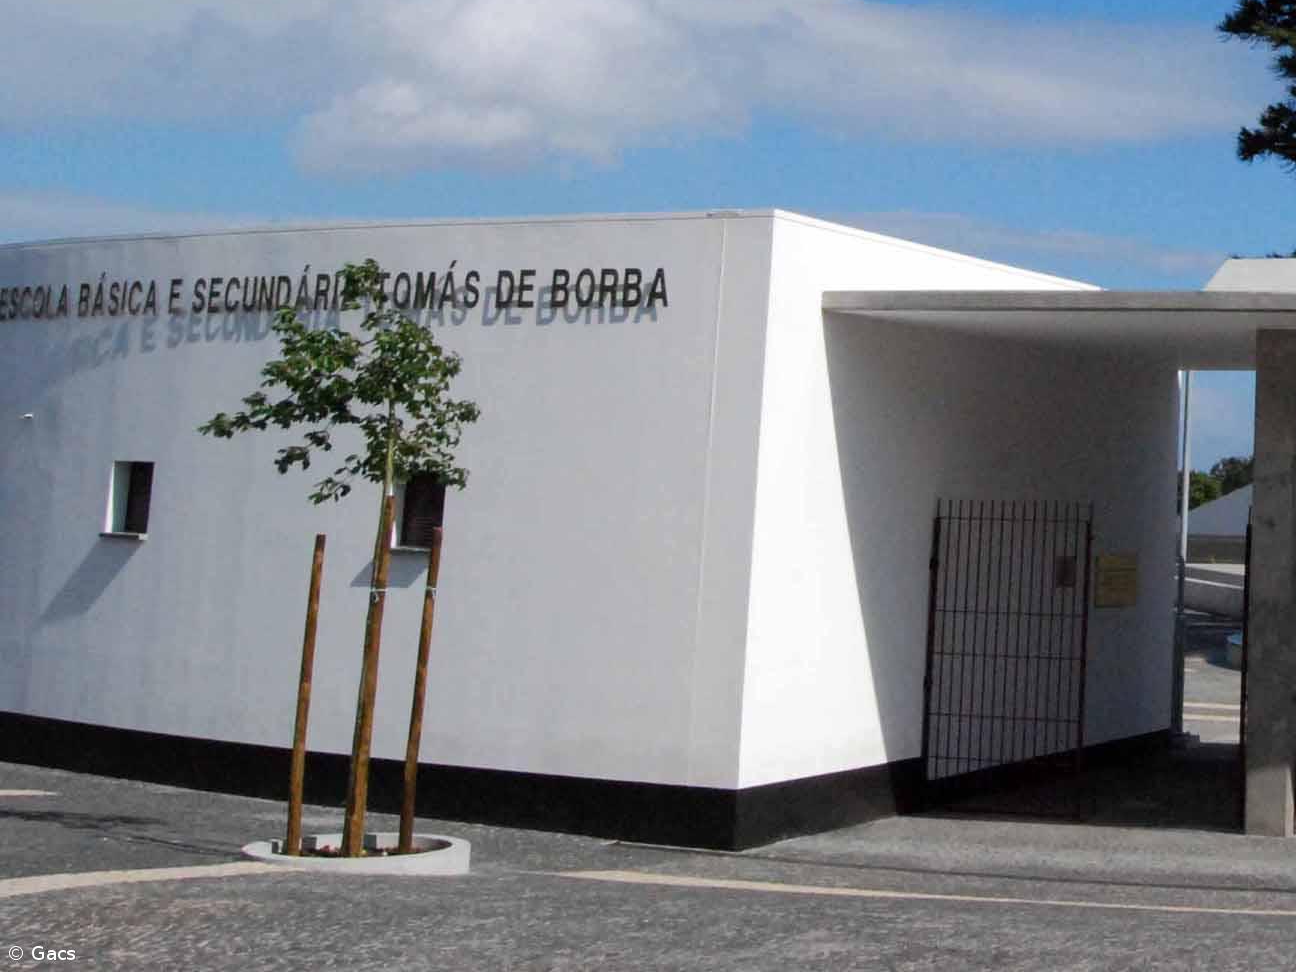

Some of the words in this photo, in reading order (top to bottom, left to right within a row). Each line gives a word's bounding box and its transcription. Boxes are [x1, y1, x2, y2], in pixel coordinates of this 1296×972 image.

[0, 283, 68, 322] ESCOLA
[77, 271, 156, 316] BÁSICA
[168, 278, 184, 313] E
[191, 264, 358, 313] SECUNDÁRI
[495, 269, 536, 309] DE
[551, 268, 668, 308] BORBA
